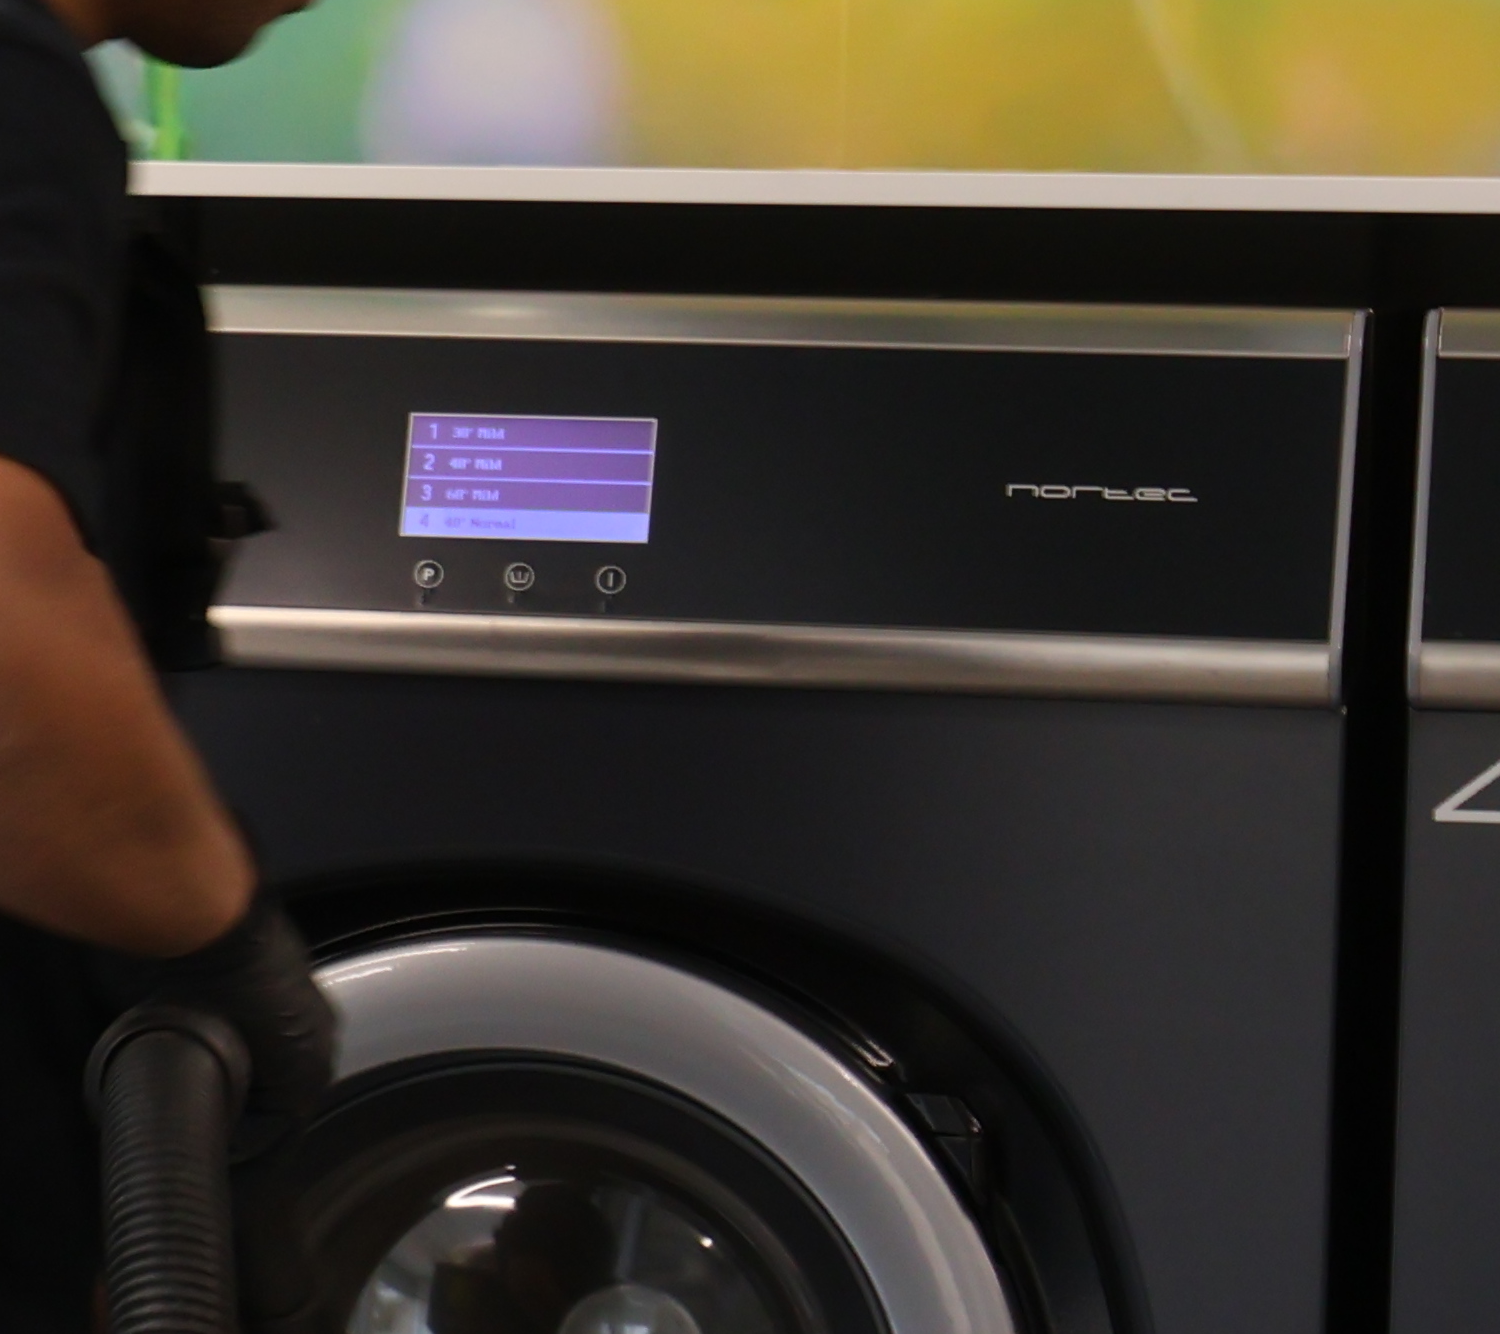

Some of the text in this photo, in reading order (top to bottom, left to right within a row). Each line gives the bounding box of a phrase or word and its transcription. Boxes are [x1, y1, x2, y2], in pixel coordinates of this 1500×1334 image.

[428, 422, 439, 440] 1
[422, 452, 437, 471] 2
[419, 483, 434, 501] 3
[1005, 483, 1199, 503] nortec
